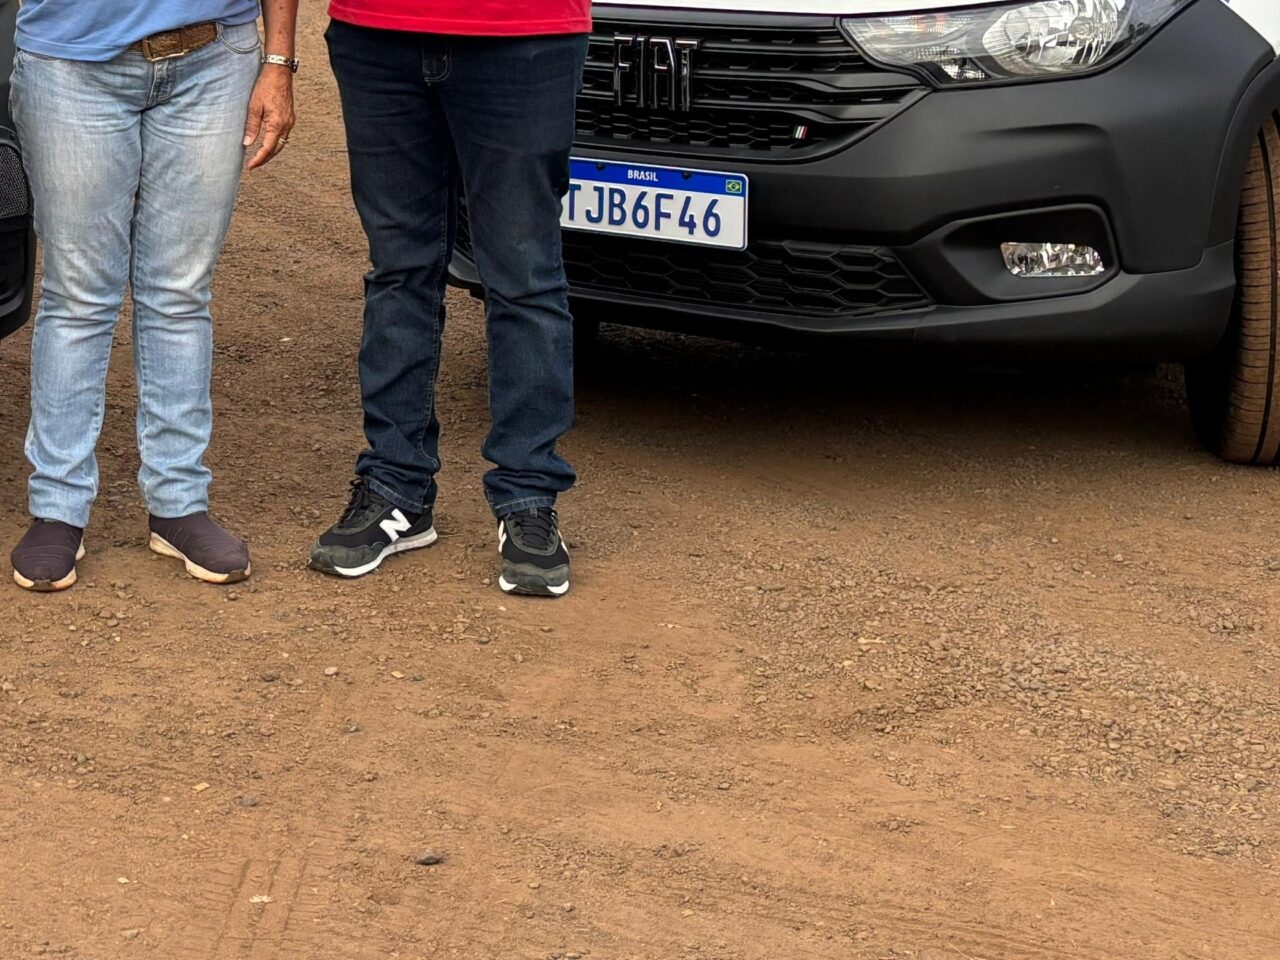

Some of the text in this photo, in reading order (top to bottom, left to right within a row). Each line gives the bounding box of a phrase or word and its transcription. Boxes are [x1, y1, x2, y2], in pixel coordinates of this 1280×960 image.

[613, 32, 698, 113] FIAT
[627, 169, 659, 183] BRASIL
[568, 183, 722, 238] TJB6F46
